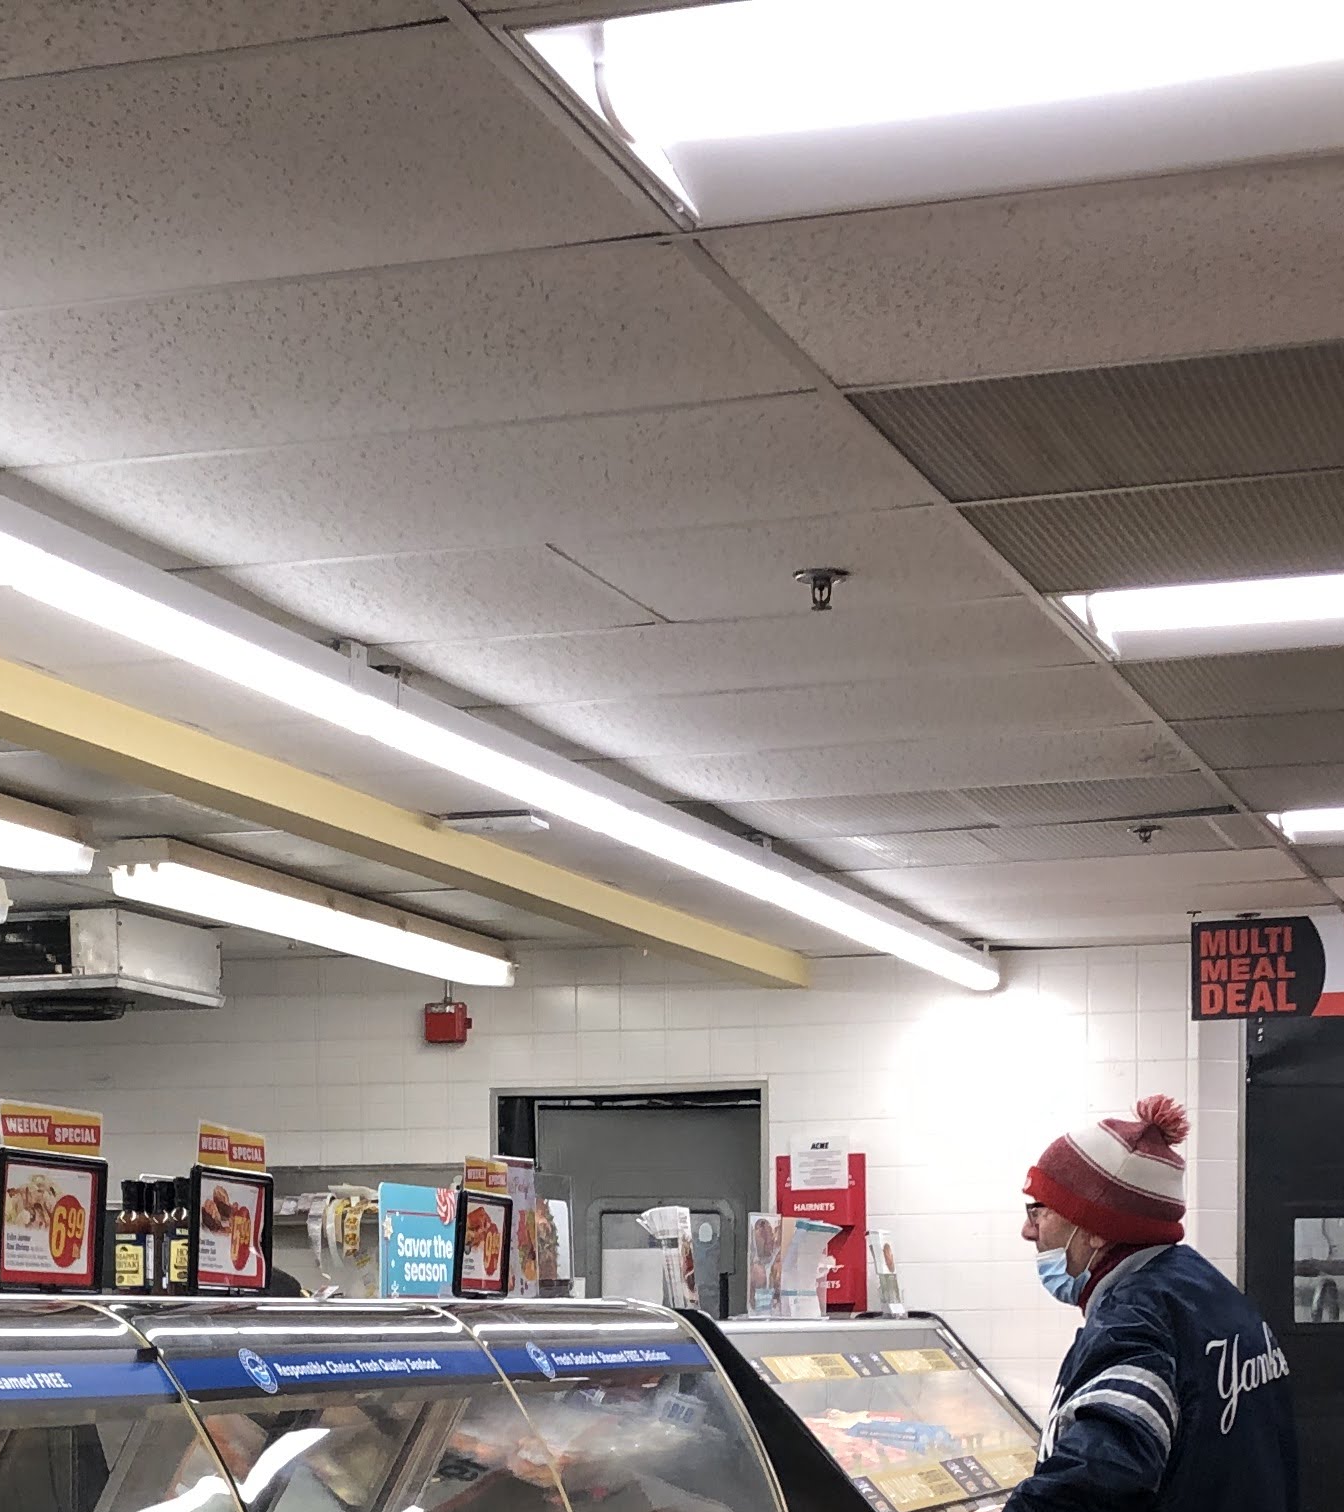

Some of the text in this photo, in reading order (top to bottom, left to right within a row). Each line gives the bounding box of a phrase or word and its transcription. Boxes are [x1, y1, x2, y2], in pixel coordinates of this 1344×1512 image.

[1200, 926, 1293, 957] MULTI
[1200, 957, 1295, 981] MEAL
[1200, 981, 1296, 1015] DEAL
[6, 1117, 97, 1144] WEEKLY SPECIAL
[201, 1135, 264, 1163] WEEKLY SPECIAL
[810, 1142, 829, 1150] ACME
[793, 1202, 835, 1212] HAIRNETS
[397, 1232, 453, 1259] Savor the
[404, 1262, 447, 1282] season
[36, 1371, 73, 1388] FREE.
[273, 1357, 442, 1380] Responsible Choice. Fresh Quality Seafood.
